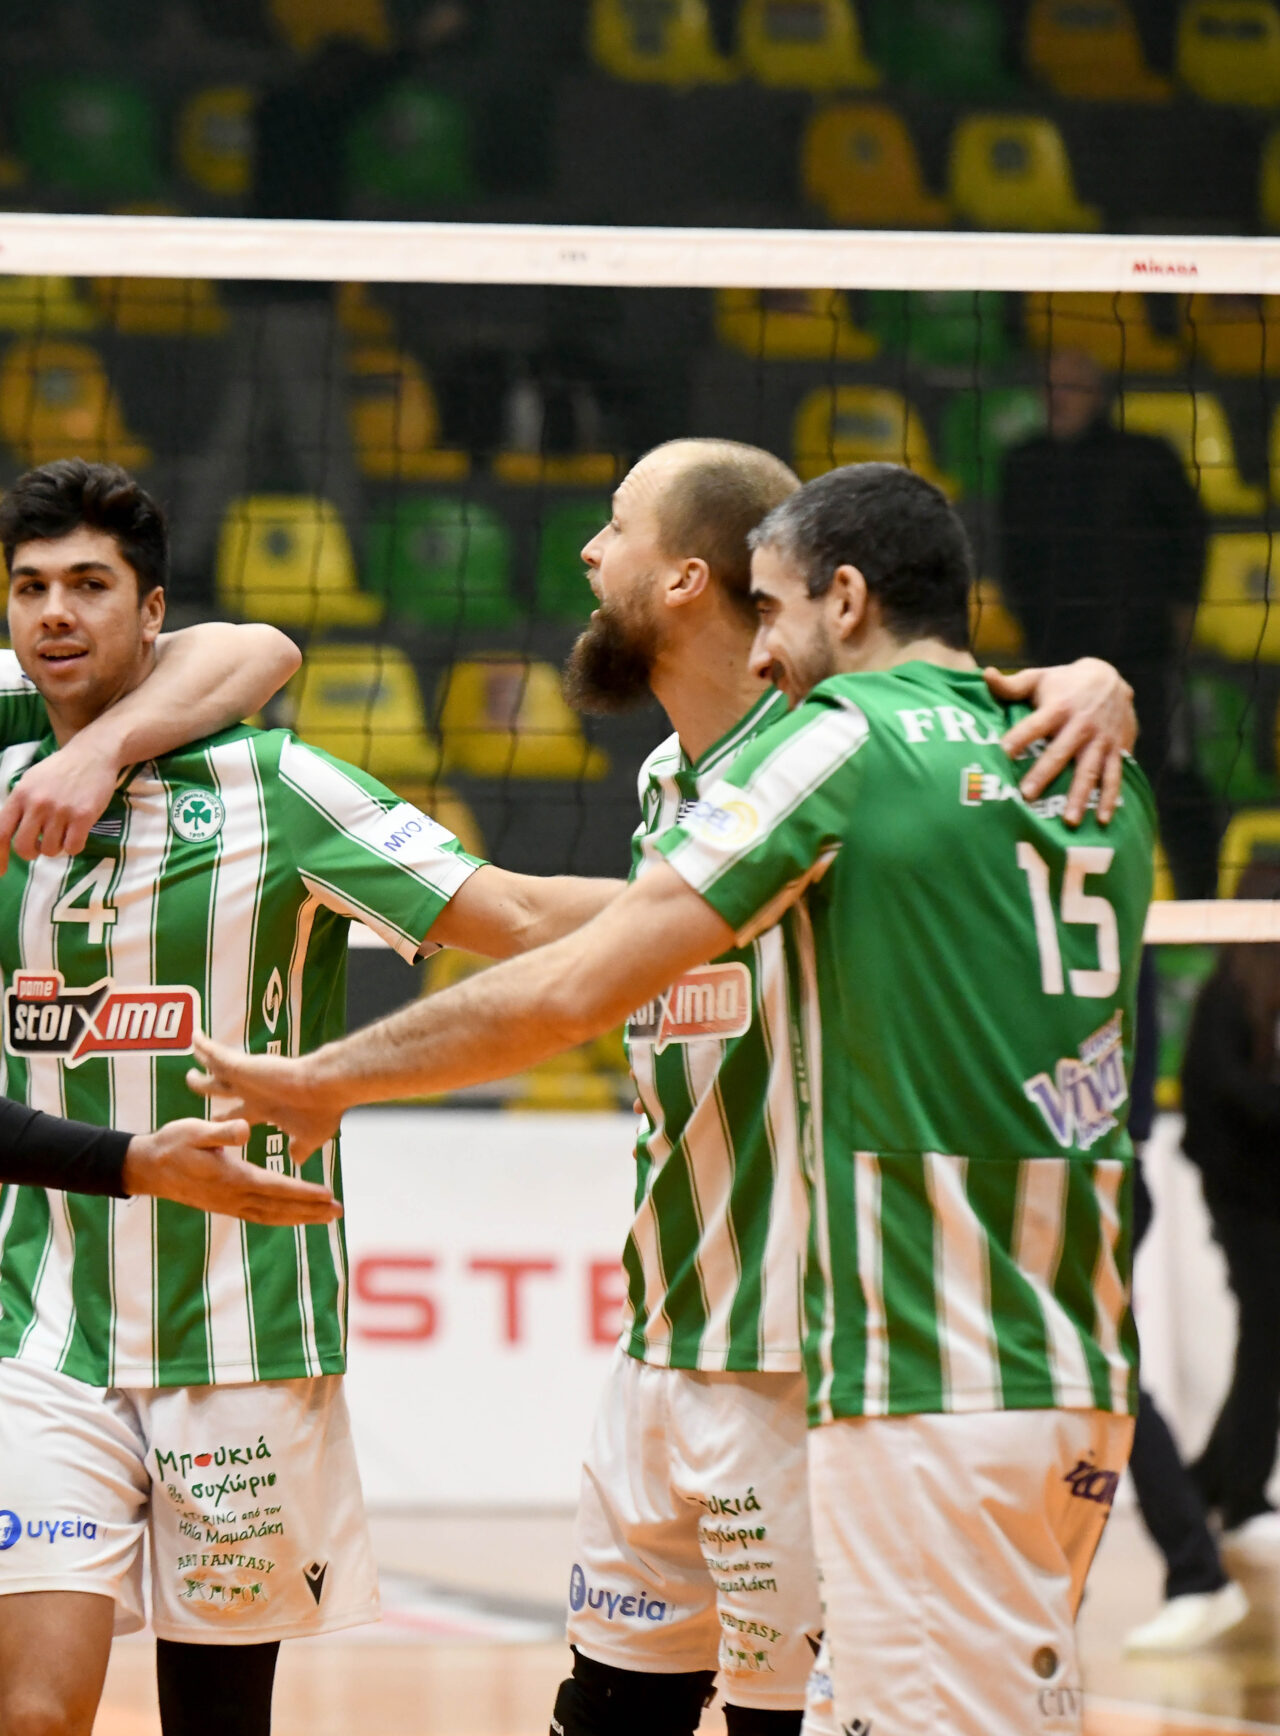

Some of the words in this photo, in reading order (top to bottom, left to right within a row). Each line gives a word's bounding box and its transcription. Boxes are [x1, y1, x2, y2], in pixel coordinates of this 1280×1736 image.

[51, 856, 118, 945] 4
[1016, 842, 1121, 998] 15
[202, 1553, 276, 1574] FANTASY
